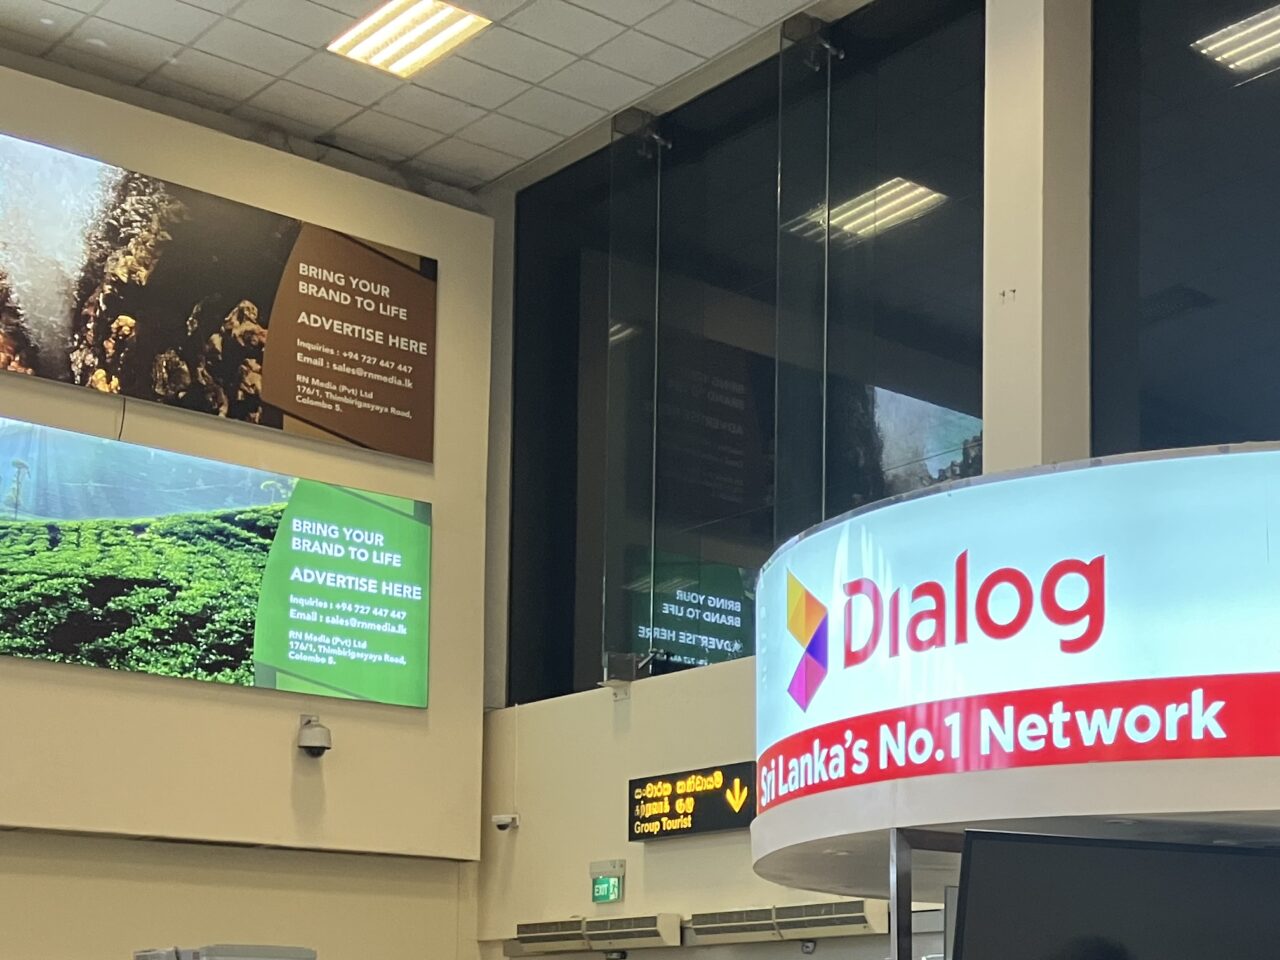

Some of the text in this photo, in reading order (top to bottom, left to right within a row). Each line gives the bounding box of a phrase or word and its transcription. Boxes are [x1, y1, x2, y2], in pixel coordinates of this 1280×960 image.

[299, 263, 390, 298] BRING YOUR
[298, 281, 407, 321] BRAND TO LIFE
[297, 312, 428, 355] ADVERTISE HERE
[297, 338, 334, 355] Inquiries
[342, 351, 359, 361] +94
[361, 355, 377, 365] 727
[379, 359, 395, 369] 447
[397, 363, 413, 373] 447
[297, 353, 324, 367] Email
[296, 374, 373, 399] RN Media (Pvt) Ltd
[296, 395, 333, 410] Colombo
[292, 518, 384, 546] BRING YOUR
[292, 537, 402, 567] BRAND TO LIFE
[290, 567, 422, 600] ADVERTISE HERE
[290, 594, 328, 609] Inquiries
[335, 602, 352, 613] +94
[355, 605, 370, 615] 727
[372, 607, 389, 618] 447
[390, 611, 407, 620] 447
[290, 609, 317, 622] Email
[842, 548, 1106, 669] Dialog
[289, 630, 367, 649] RN Media (Pvt) Ltd
[288, 651, 326, 663] Colombo
[760, 687, 1228, 808] Sri Lanka’s No.1 Network
[634, 815, 692, 835] Group Tourist
[595, 884, 608, 896] EXIT
